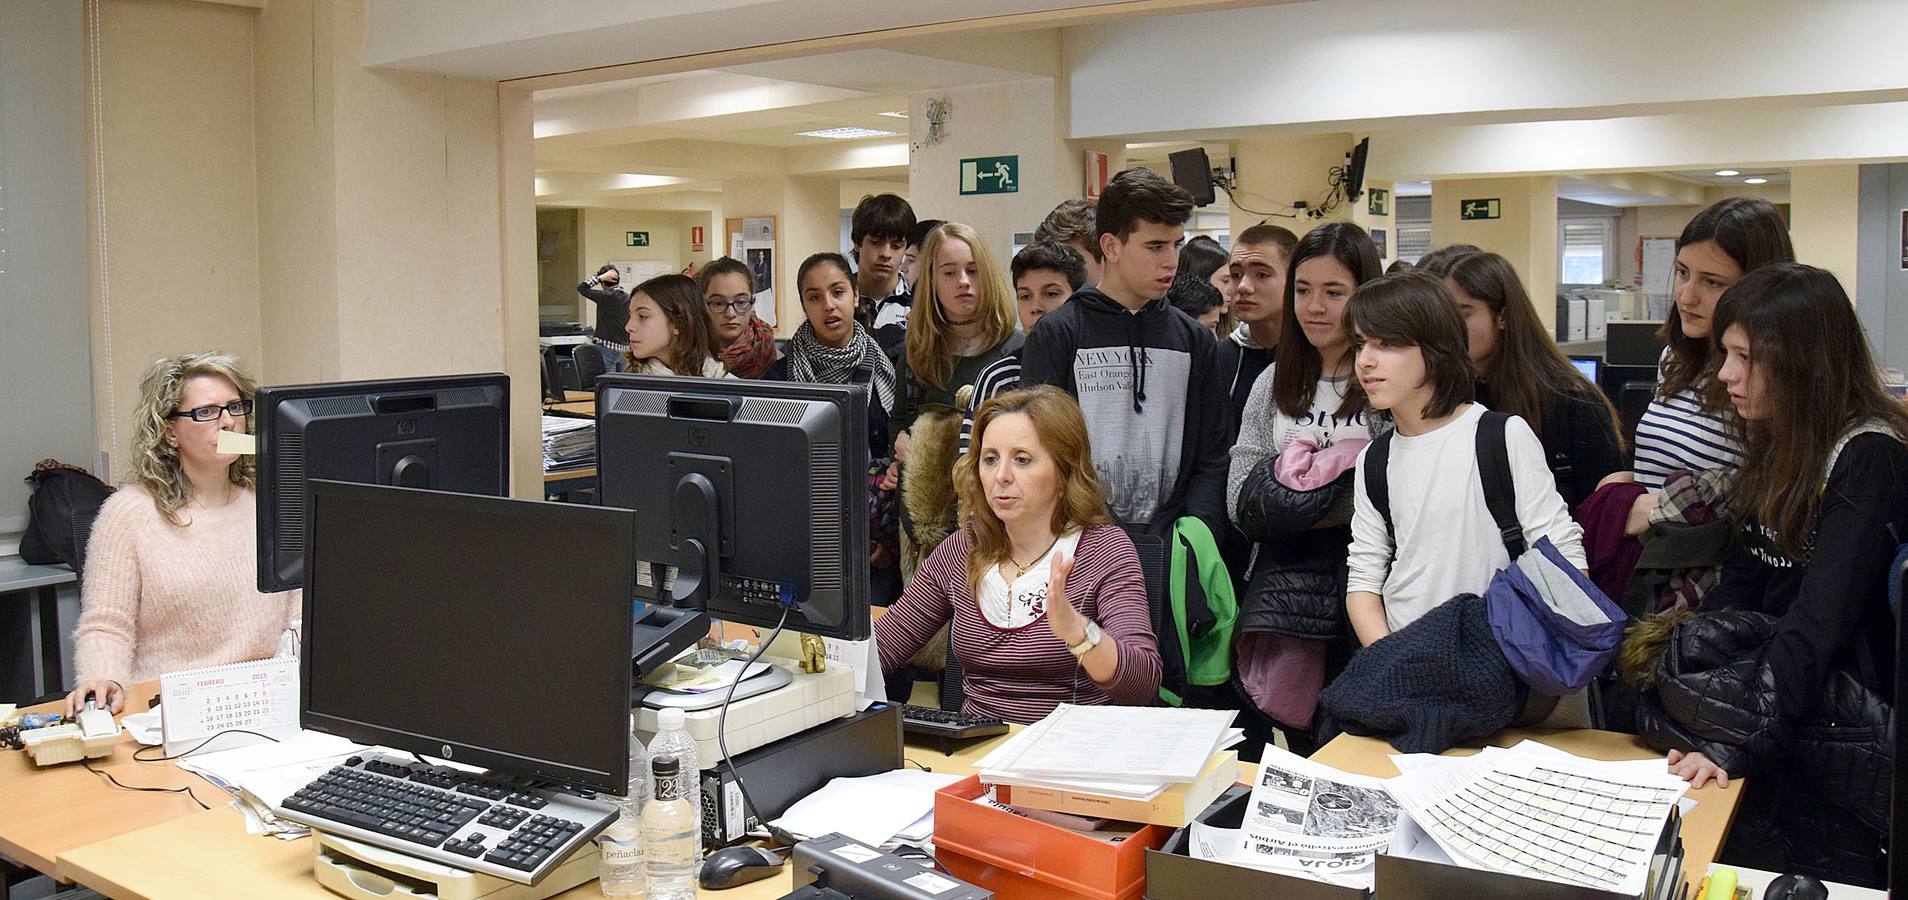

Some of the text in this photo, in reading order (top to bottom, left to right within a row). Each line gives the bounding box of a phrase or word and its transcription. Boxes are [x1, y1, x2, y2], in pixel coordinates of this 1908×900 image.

[1076, 351, 1109, 365] NEW
[1078, 370, 1098, 380] East
[1080, 382, 1115, 393] Hudson
[197, 678, 225, 687] FEBRERO
[251, 672, 268, 680] 2015
[606, 847, 645, 859] peñaclar
[1298, 857, 1366, 869] RIOJA
